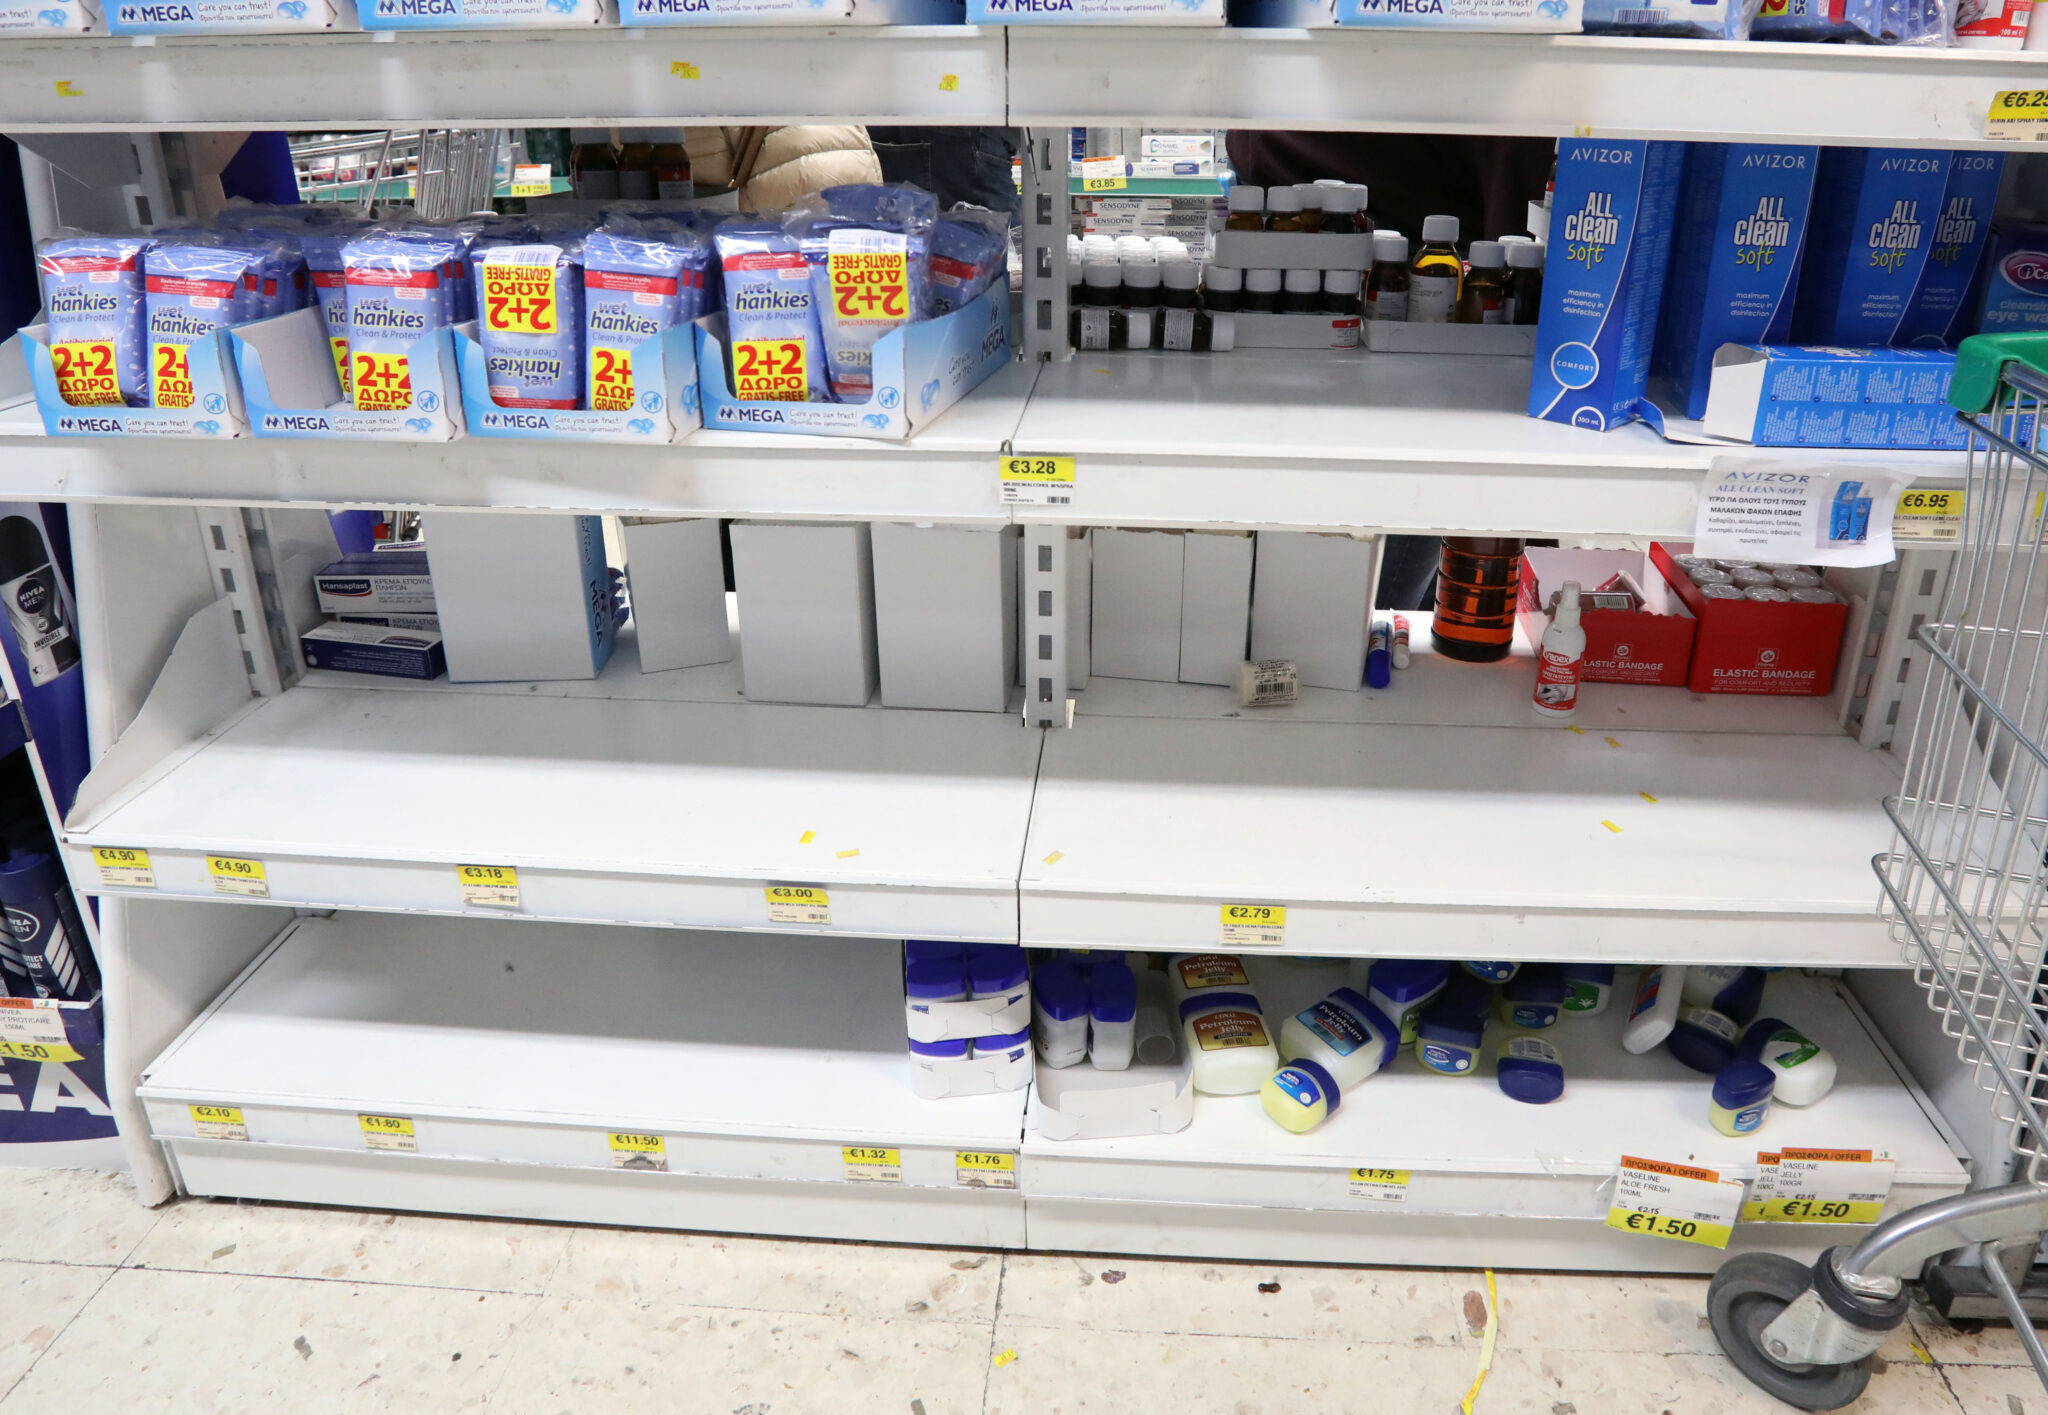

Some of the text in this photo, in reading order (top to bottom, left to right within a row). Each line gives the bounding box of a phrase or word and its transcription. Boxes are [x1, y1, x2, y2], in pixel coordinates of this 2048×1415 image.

[198, 1, 272, 13] Care you can trust!
[402, 0, 456, 15] MEGA
[659, 0, 710, 13] MEGA
[1015, 0, 1074, 12] MEGA
[1387, 0, 1443, 14] MEGA
[140, 5, 193, 22] MEGA
[2003, 92, 2048, 107] €6.25
[1571, 149, 1633, 165] AVIZOR
[1742, 155, 1806, 169] AVIZOR
[1880, 158, 1940, 173] AVIZOR
[1090, 178, 1115, 188] €3.85
[1584, 191, 1613, 217] ALL
[1756, 196, 1785, 221] ALL
[1946, 197, 1973, 219] ALL
[1890, 200, 1918, 224] ALL
[1563, 210, 1619, 245] clean
[1733, 215, 1790, 247] clean
[1868, 218, 1922, 249] clean
[1567, 237, 1605, 270] soft
[1735, 240, 1776, 273] soft
[1869, 241, 1908, 275] soft
[833, 255, 903, 270] GRATIS-FREE
[486, 266, 551, 280] GRATIS-FREE
[835, 270, 901, 284] ΔΩΡΟ
[55, 285, 83, 297] wet
[488, 281, 549, 296] ΔΩΡΟ
[743, 281, 772, 294] wet
[1567, 289, 1601, 299] maximum
[51, 293, 118, 312] hankies
[736, 291, 809, 311] hankies
[835, 285, 904, 317] 2+2
[1562, 297, 1605, 309] efficiency in
[1868, 293, 1900, 301] maximum
[360, 299, 388, 310] wet
[598, 302, 627, 315] wet
[54, 312, 115, 323] Clean & Protect
[157, 307, 183, 318] wet
[353, 307, 424, 330] hankies
[488, 296, 551, 330] 2+2
[739, 311, 807, 324] Clean & Protect
[1562, 306, 1601, 318] disinfection
[1985, 310, 2018, 324] eye
[151, 314, 214, 338] hankies
[591, 311, 659, 335] hankies
[153, 335, 176, 346] Clean
[356, 328, 421, 341] Clean & Protect
[592, 332, 616, 345] Clean
[492, 346, 557, 358] Clean Protect
[53, 345, 114, 378] 2+2
[737, 343, 803, 376] 2+2
[1556, 359, 1595, 372] COMFORT
[357, 356, 410, 389] 2+2
[490, 358, 561, 379] hankies
[59, 377, 114, 392] ΔΩΡΟ
[525, 374, 553, 386] wet
[739, 376, 802, 391] ΔΩΡΟ
[738, 390, 805, 401] GRATIS-FREE
[125, 417, 188, 427] Care can trust!
[333, 416, 349, 425] Care
[379, 416, 400, 425] trust!
[503, 415, 549, 428] MEGA
[601, 415, 623, 425] trust!
[739, 409, 785, 424] MEGA
[77, 419, 122, 433] MEGA
[284, 418, 330, 431] MEGA
[1009, 460, 1055, 475] €3.28
[1724, 471, 1811, 483] AVIZOR
[1716, 484, 1807, 496] ALL CLEAN SOFT
[1781, 498, 1807, 506] ΤΥΠΟΥΣ
[1903, 494, 1950, 508] €6.95
[1746, 507, 1772, 515] ΦΑΚΩΝ
[1774, 508, 1802, 516] ΕΠΑΦΗΣ
[322, 582, 368, 591] Hansaplast
[374, 578, 401, 586] ΚΡΕΜΑ
[375, 584, 407, 592] ΠΛΗΓΩΝ
[19, 585, 46, 603] NIVEA
[24, 594, 44, 609] MEN
[33, 629, 62, 649] INVISIBLE
[1584, 660, 1664, 671] LASTIC BANDAGE
[1713, 668, 1817, 679] ELASTIC BANDAGE
[99, 849, 135, 862] €4.90
[215, 860, 251, 873] €4.90
[464, 867, 503, 878] €3.18
[773, 888, 813, 898] €3.00
[1229, 906, 1271, 919] €2.79
[1184, 960, 1237, 971] Petroleum
[1203, 966, 1226, 974] Jelly
[1199, 1018, 1257, 1030] Petroleum
[1318, 1004, 1363, 1041] Petroleum
[1326, 1016, 1346, 1035] Jelly
[1220, 1025, 1245, 1034] Jelly
[196, 1106, 231, 1118] €2.10
[366, 1117, 401, 1129] €1.80
[616, 1134, 659, 1146] €11.50
[850, 1148, 887, 1159] €1.32
[963, 1153, 1001, 1165] €1.76
[1785, 1151, 1862, 1162] ΠΡΟΣΦΟΡΑ OFFER
[1624, 1159, 1708, 1181] ΠΡΟΣΦΟΡΑ OFFER
[1782, 1162, 1819, 1171] VASELINE
[1357, 1168, 1395, 1179] €1.75
[1622, 1170, 1661, 1184] VASELINE
[1779, 1171, 1802, 1180] JELLY
[1621, 1180, 1671, 1196] ALOE FRESH
[1779, 1179, 1803, 1188] 100GR
[1619, 1189, 1643, 1200] 100ML
[1794, 1193, 1816, 1201] €2.15
[1637, 1204, 1659, 1215] €2.15
[1782, 1202, 1850, 1219] €1.50
[1625, 1213, 1697, 1239] €1.50
